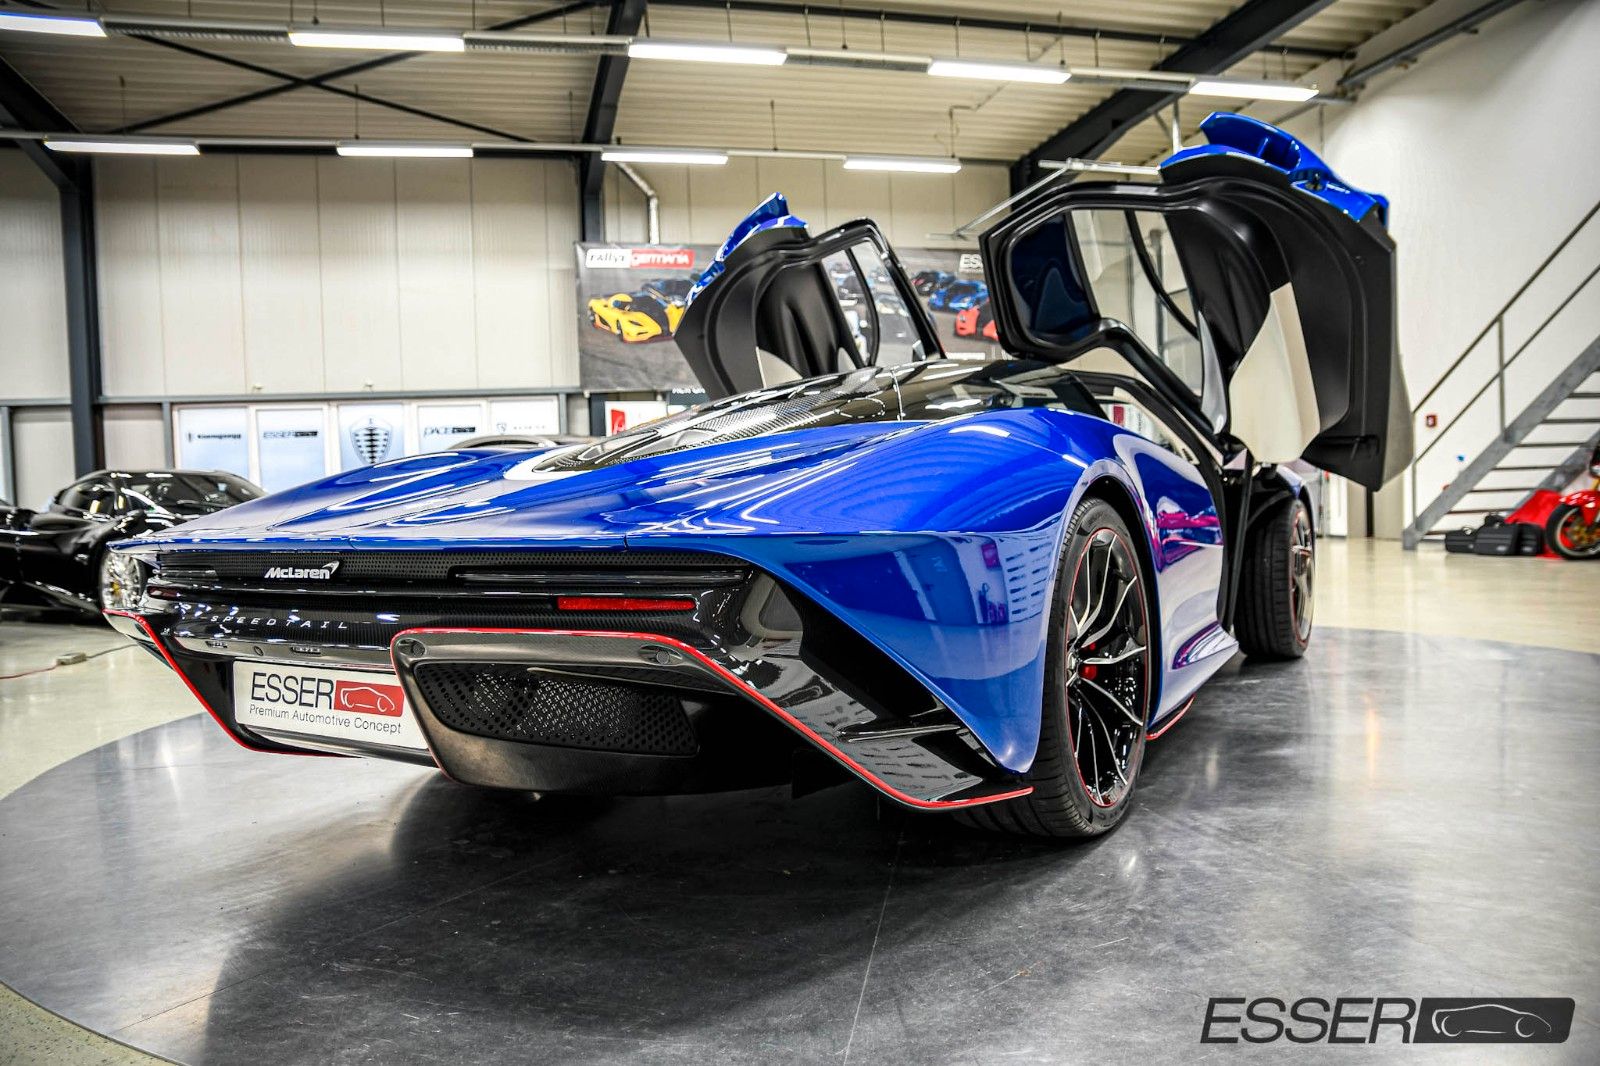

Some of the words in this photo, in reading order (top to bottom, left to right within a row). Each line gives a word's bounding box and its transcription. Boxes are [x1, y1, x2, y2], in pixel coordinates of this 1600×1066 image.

[264, 566, 330, 579] McLaren
[210, 615, 348, 629] SPEEDTAIL
[251, 671, 334, 710] ESSER
[250, 703, 290, 719] Premium
[292, 709, 350, 728] Automotive
[354, 717, 402, 735] Concept
